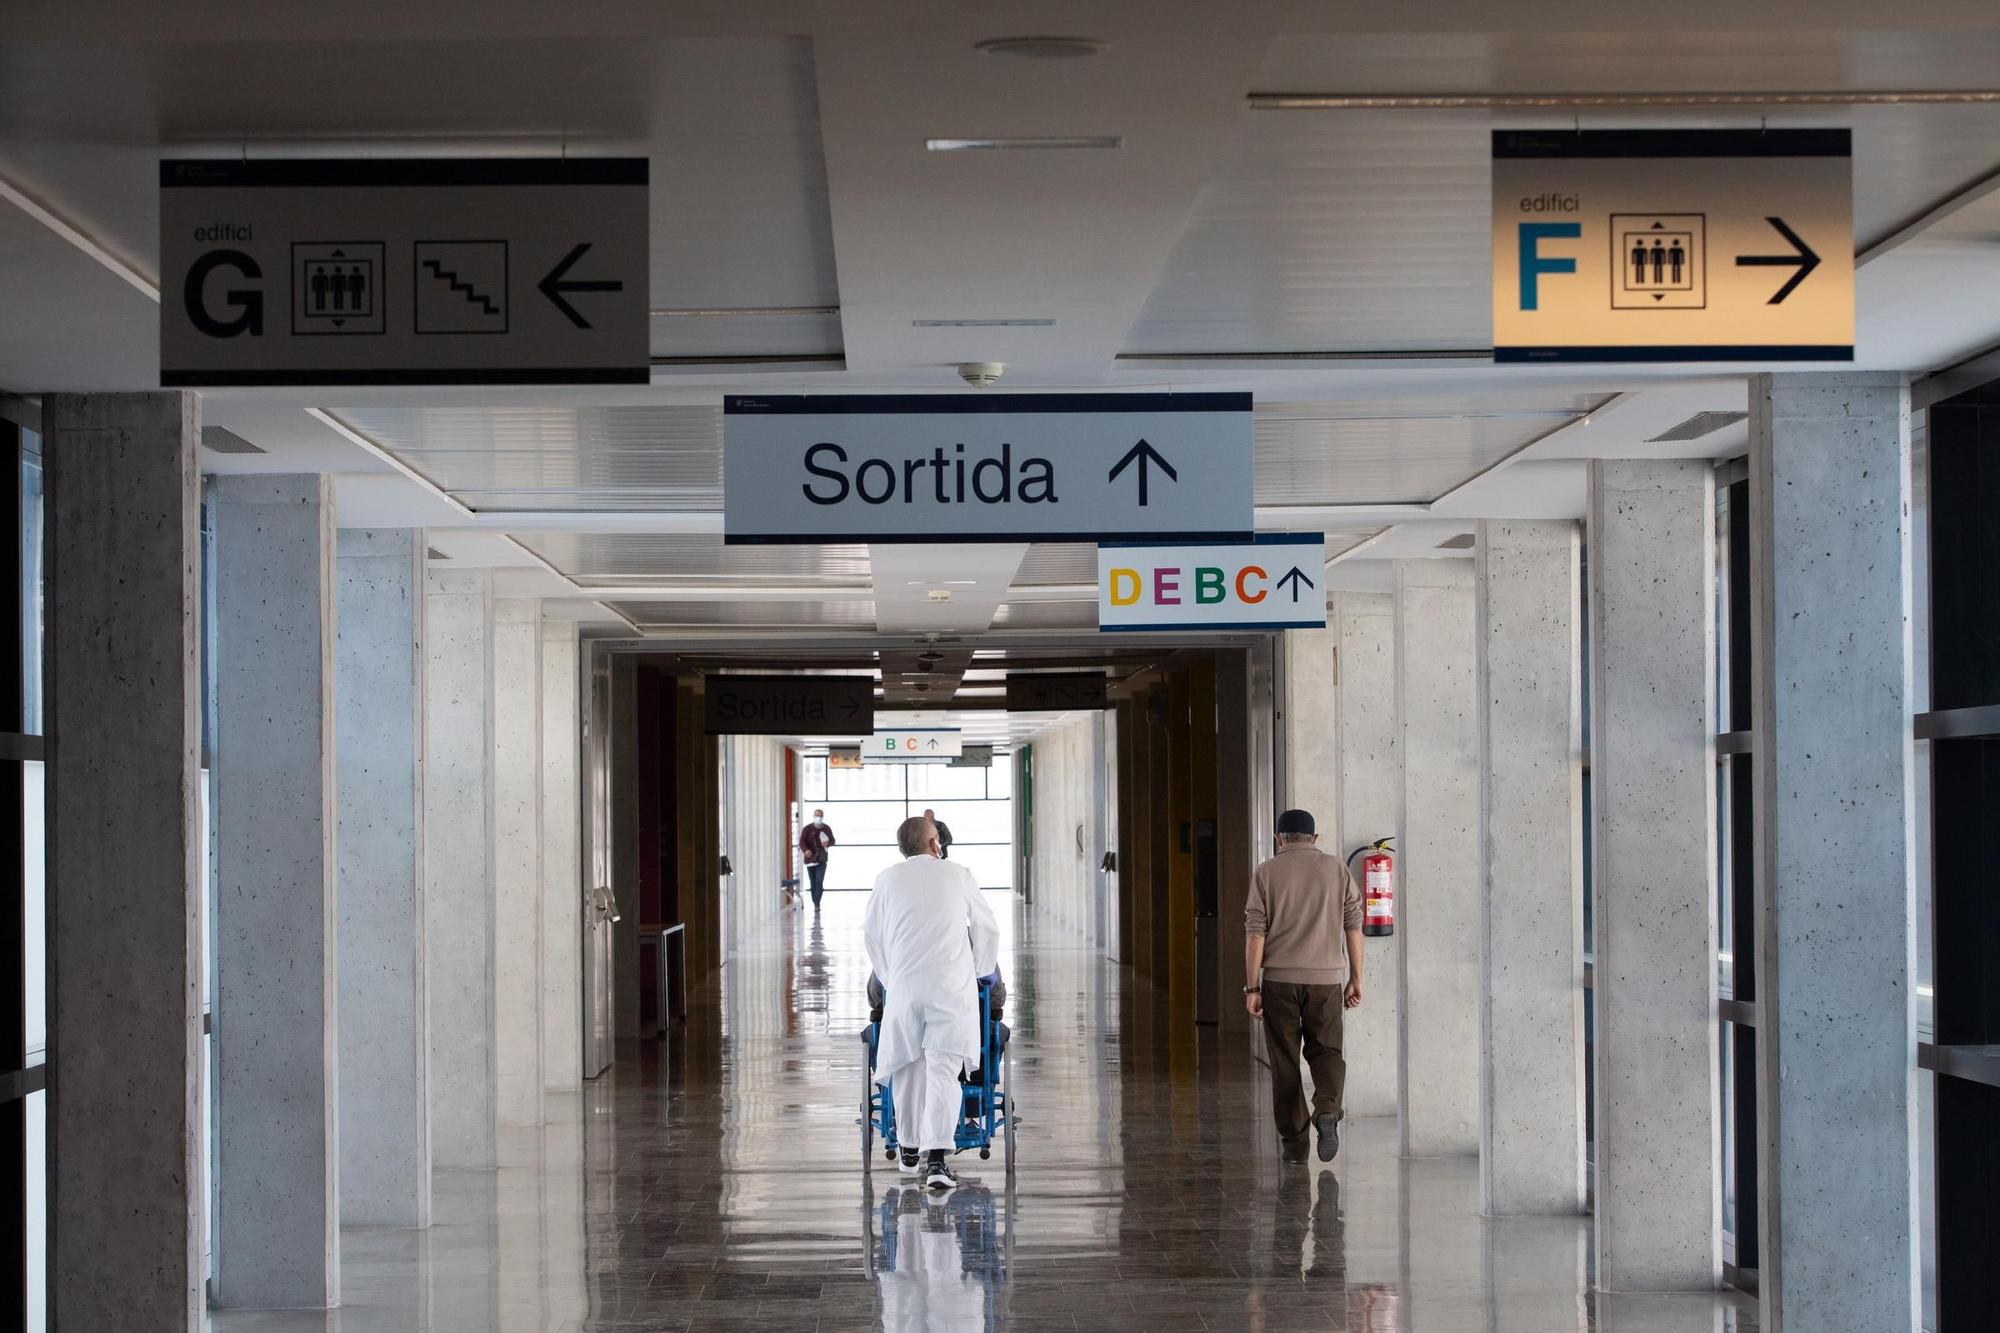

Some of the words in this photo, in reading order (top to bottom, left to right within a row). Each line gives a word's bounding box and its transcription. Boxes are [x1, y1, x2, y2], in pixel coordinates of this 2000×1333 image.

[1519, 194, 1580, 212] edifici
[194, 224, 254, 241] edifici
[1518, 223, 1581, 311] F
[184, 249, 263, 338] G
[801, 442, 1059, 506] Sortida
[718, 692, 825, 721] Sortida
[886, 738, 896, 750] B
[907, 738, 917, 750] C
